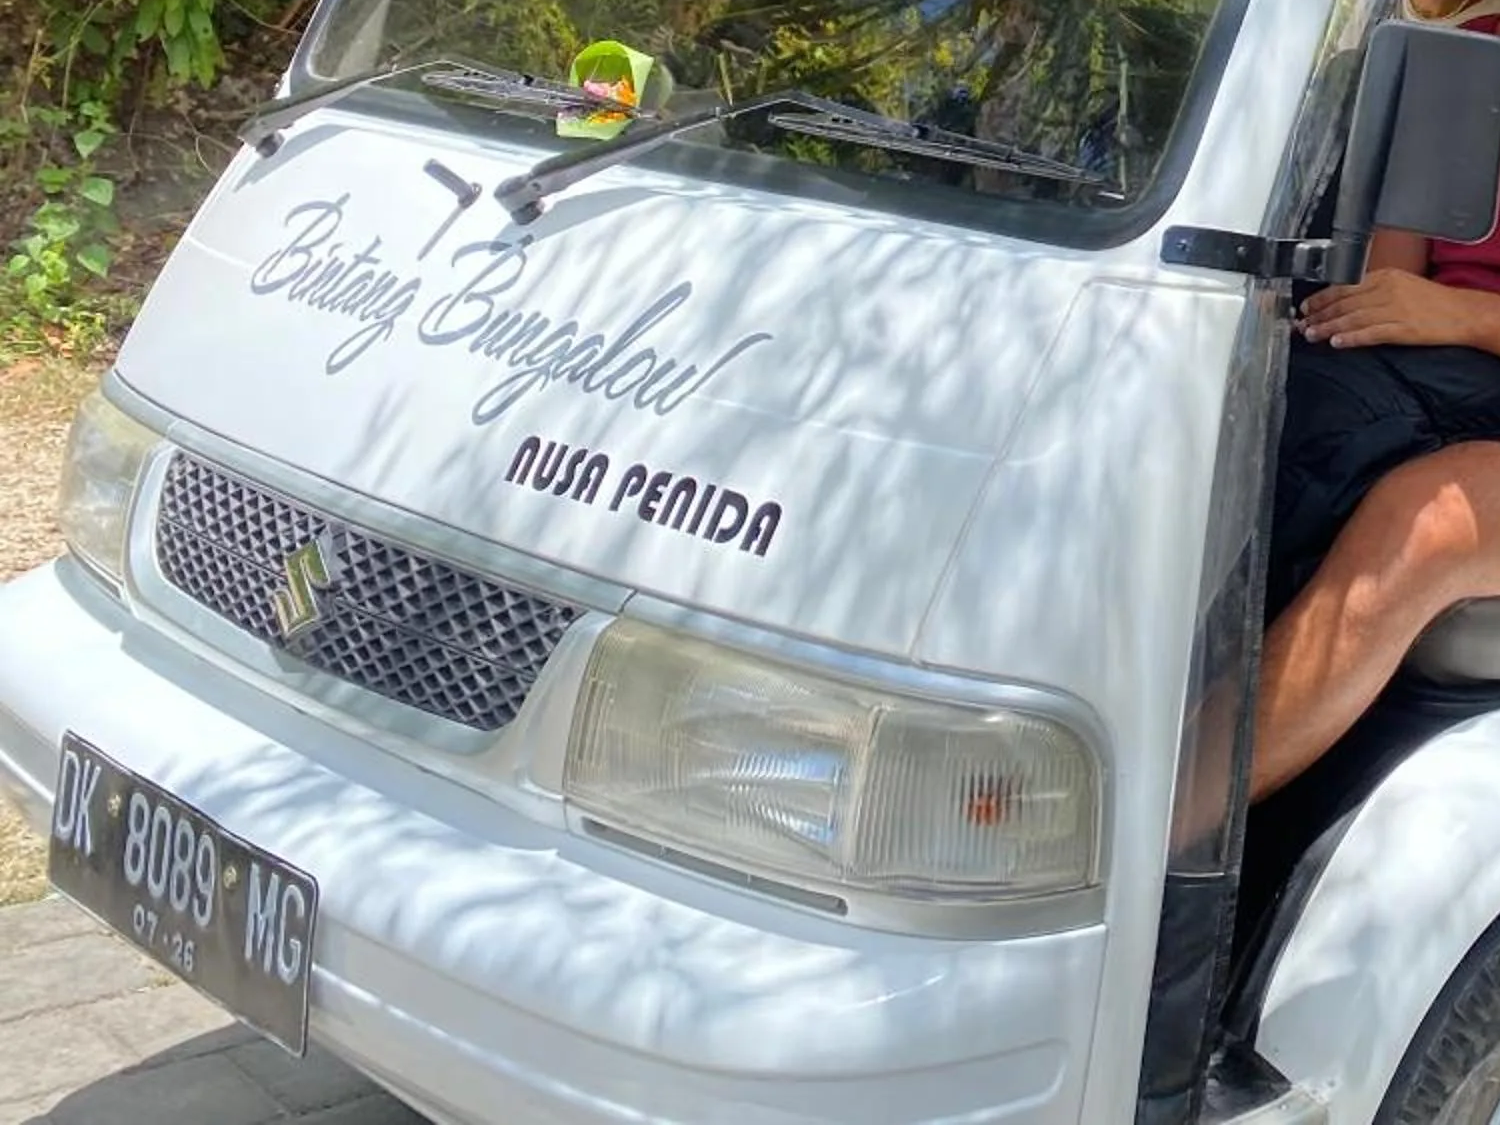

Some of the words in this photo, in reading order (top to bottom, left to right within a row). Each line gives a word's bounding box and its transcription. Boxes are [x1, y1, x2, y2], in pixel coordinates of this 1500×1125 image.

[252, 193, 421, 375] Bintang
[418, 234, 773, 425] Bungalow
[504, 436, 609, 505] NUSA
[610, 463, 783, 558] PENIDA
[56, 750, 101, 858] DK
[124, 792, 216, 927] 8089
[245, 862, 304, 985] MG
